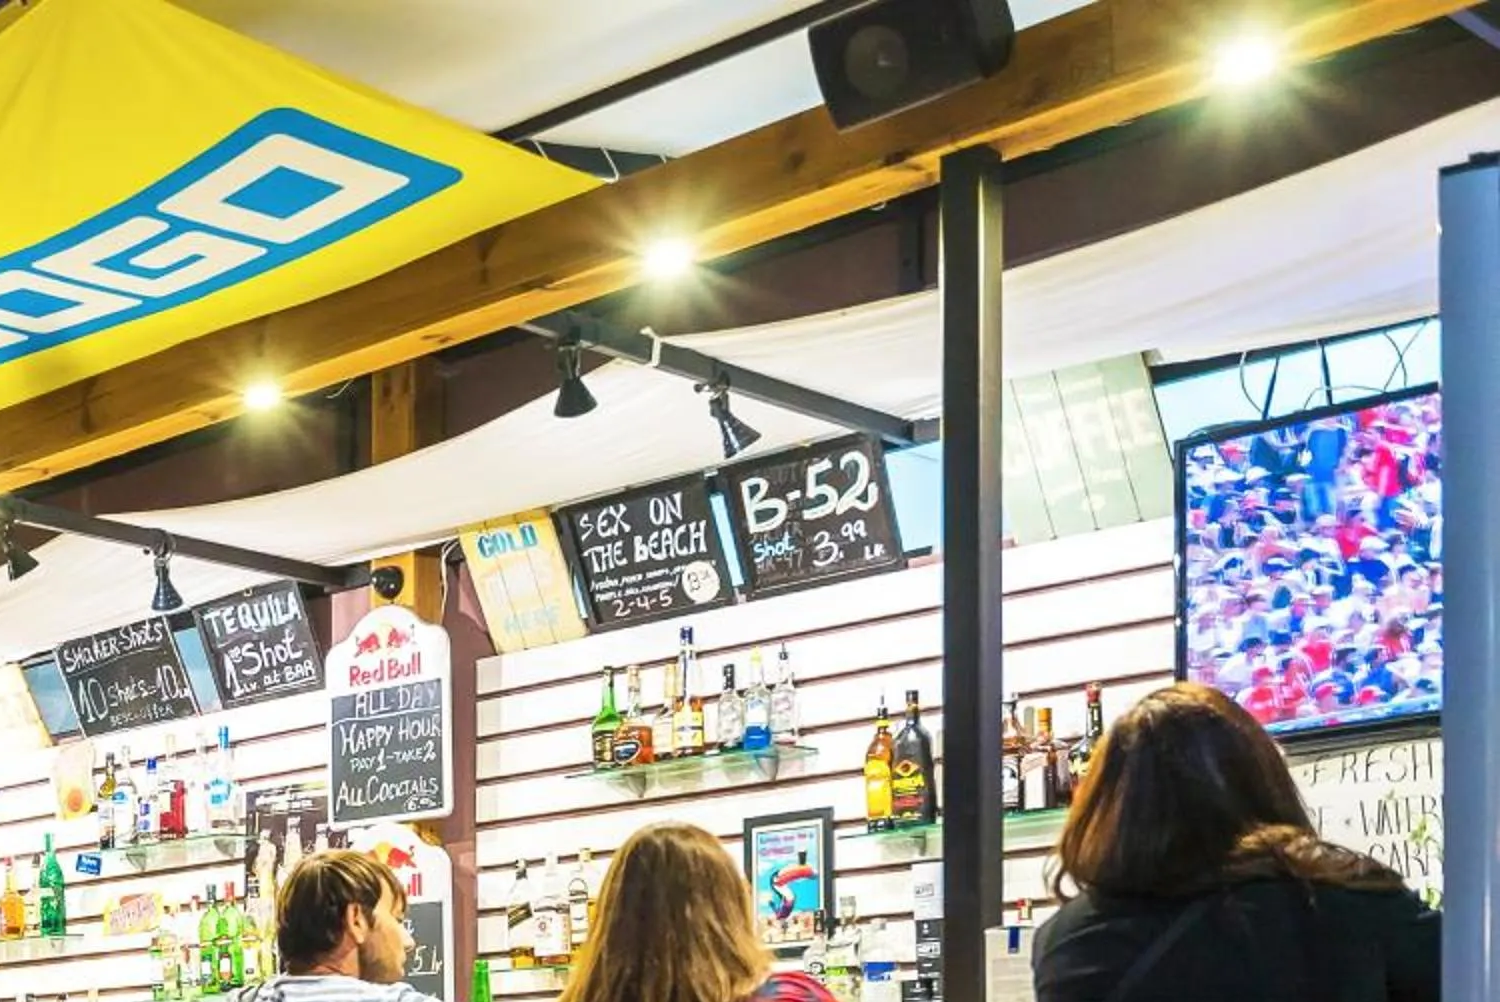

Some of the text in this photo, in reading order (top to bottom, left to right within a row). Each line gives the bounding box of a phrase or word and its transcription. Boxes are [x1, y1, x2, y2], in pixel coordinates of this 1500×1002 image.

[740, 450, 878, 534] B-52
[580, 491, 683, 541] SEX ON
[583, 540, 628, 574] THE
[203, 591, 302, 638] TEQUILA
[241, 628, 303, 675] Shot
[349, 652, 422, 688] Red Bull
[339, 713, 442, 757] HAPPY HOUR
[1310, 741, 1434, 788] FRESH
